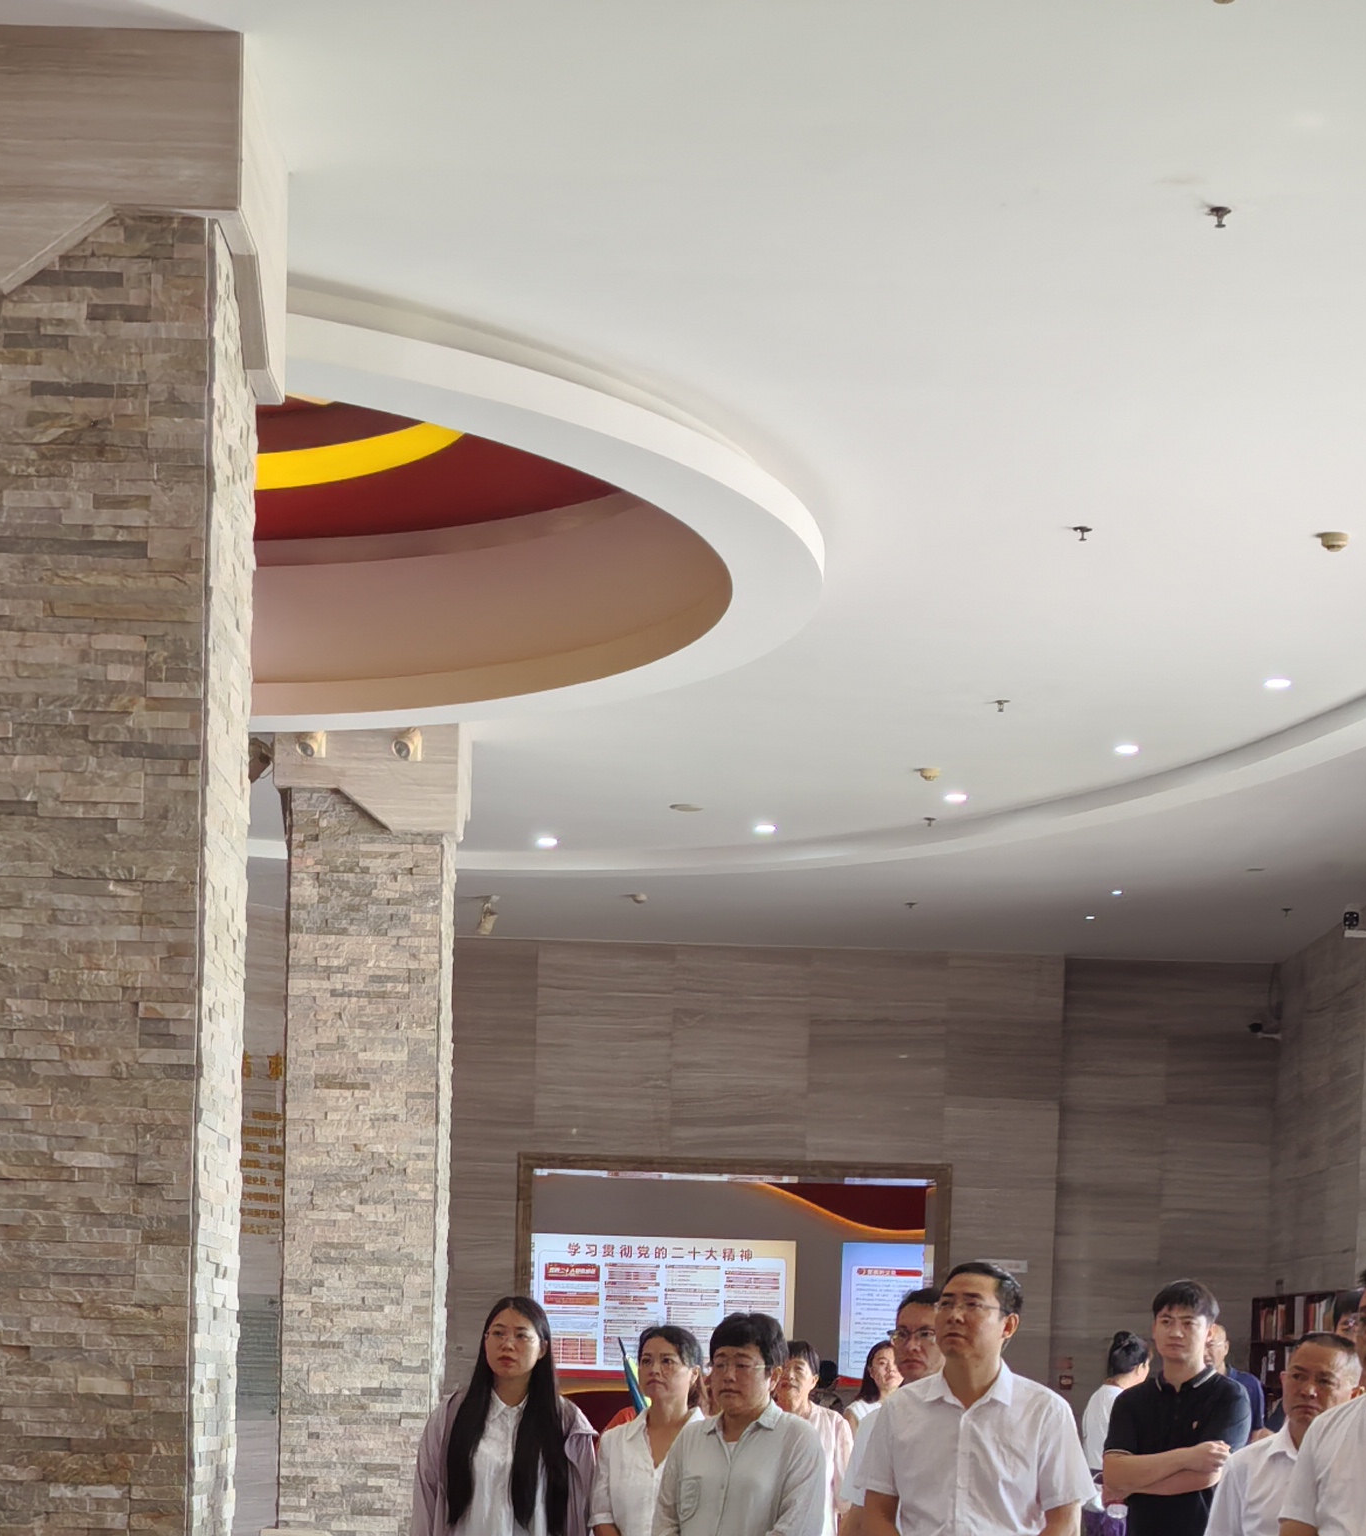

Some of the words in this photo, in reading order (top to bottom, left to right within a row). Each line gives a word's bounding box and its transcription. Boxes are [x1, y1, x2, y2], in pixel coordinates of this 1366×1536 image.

[567, 1242, 754, 1263] 学习贯彻党的二十大精神
